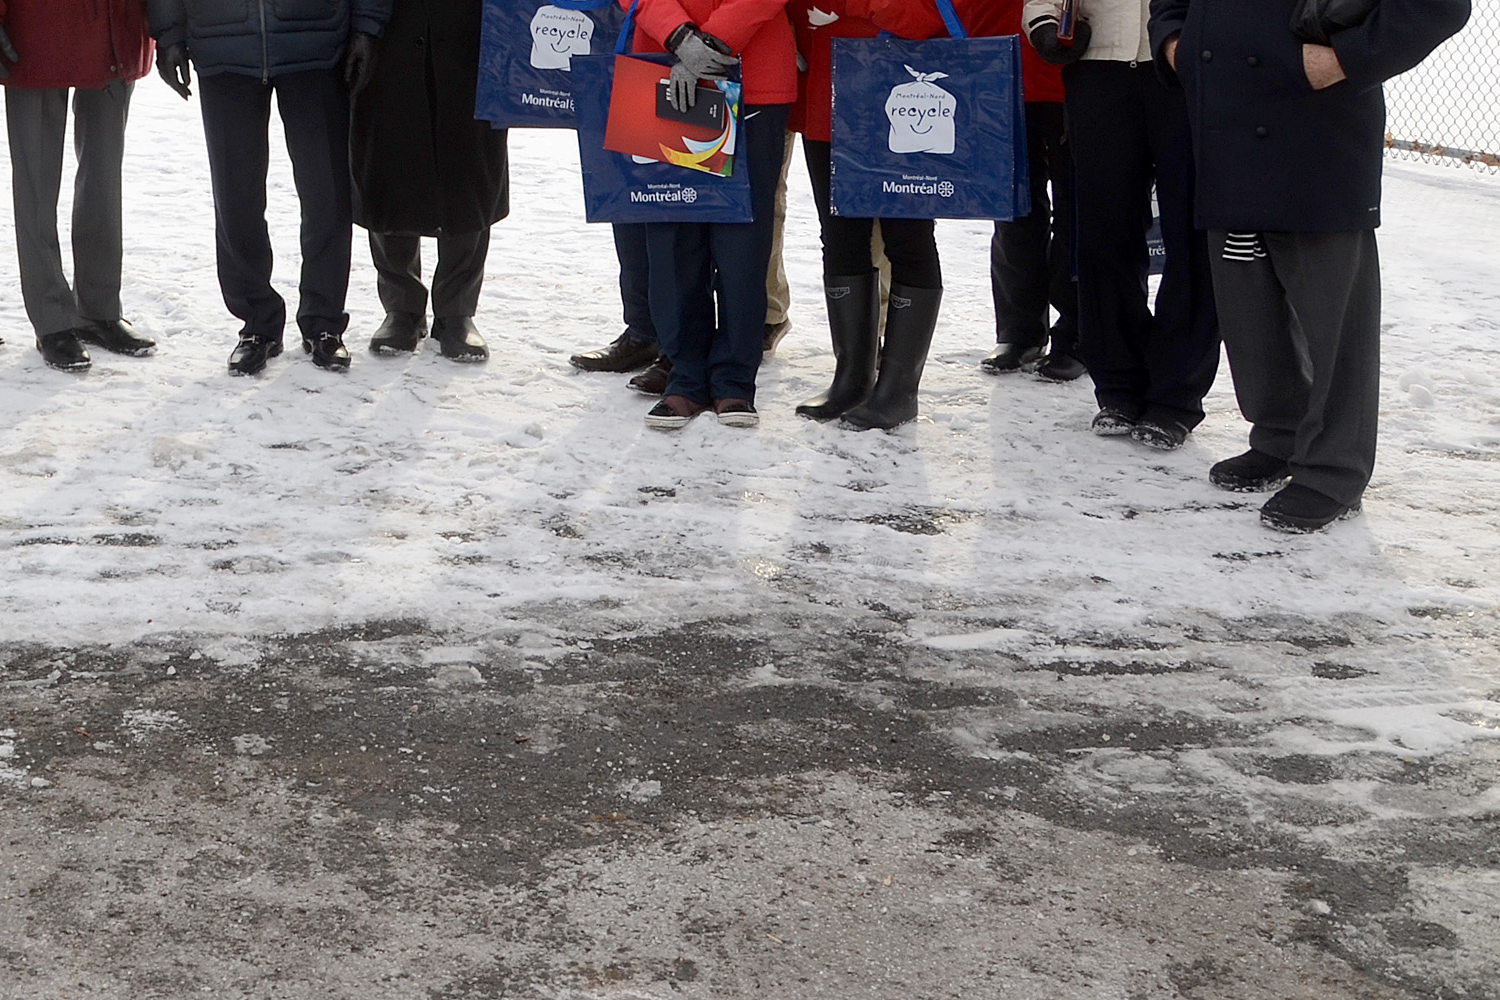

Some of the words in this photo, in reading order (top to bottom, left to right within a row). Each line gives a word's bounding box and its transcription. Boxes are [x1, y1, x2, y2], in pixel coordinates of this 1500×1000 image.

[541, 13, 586, 23] Montréal-Nord
[535, 24, 588, 46] recycle
[521, 93, 570, 110] Montréal
[896, 92, 946, 100] Montréal-Nord
[891, 100, 951, 127] recycle
[883, 181, 937, 195] Montréal
[630, 190, 681, 203] Montréal
